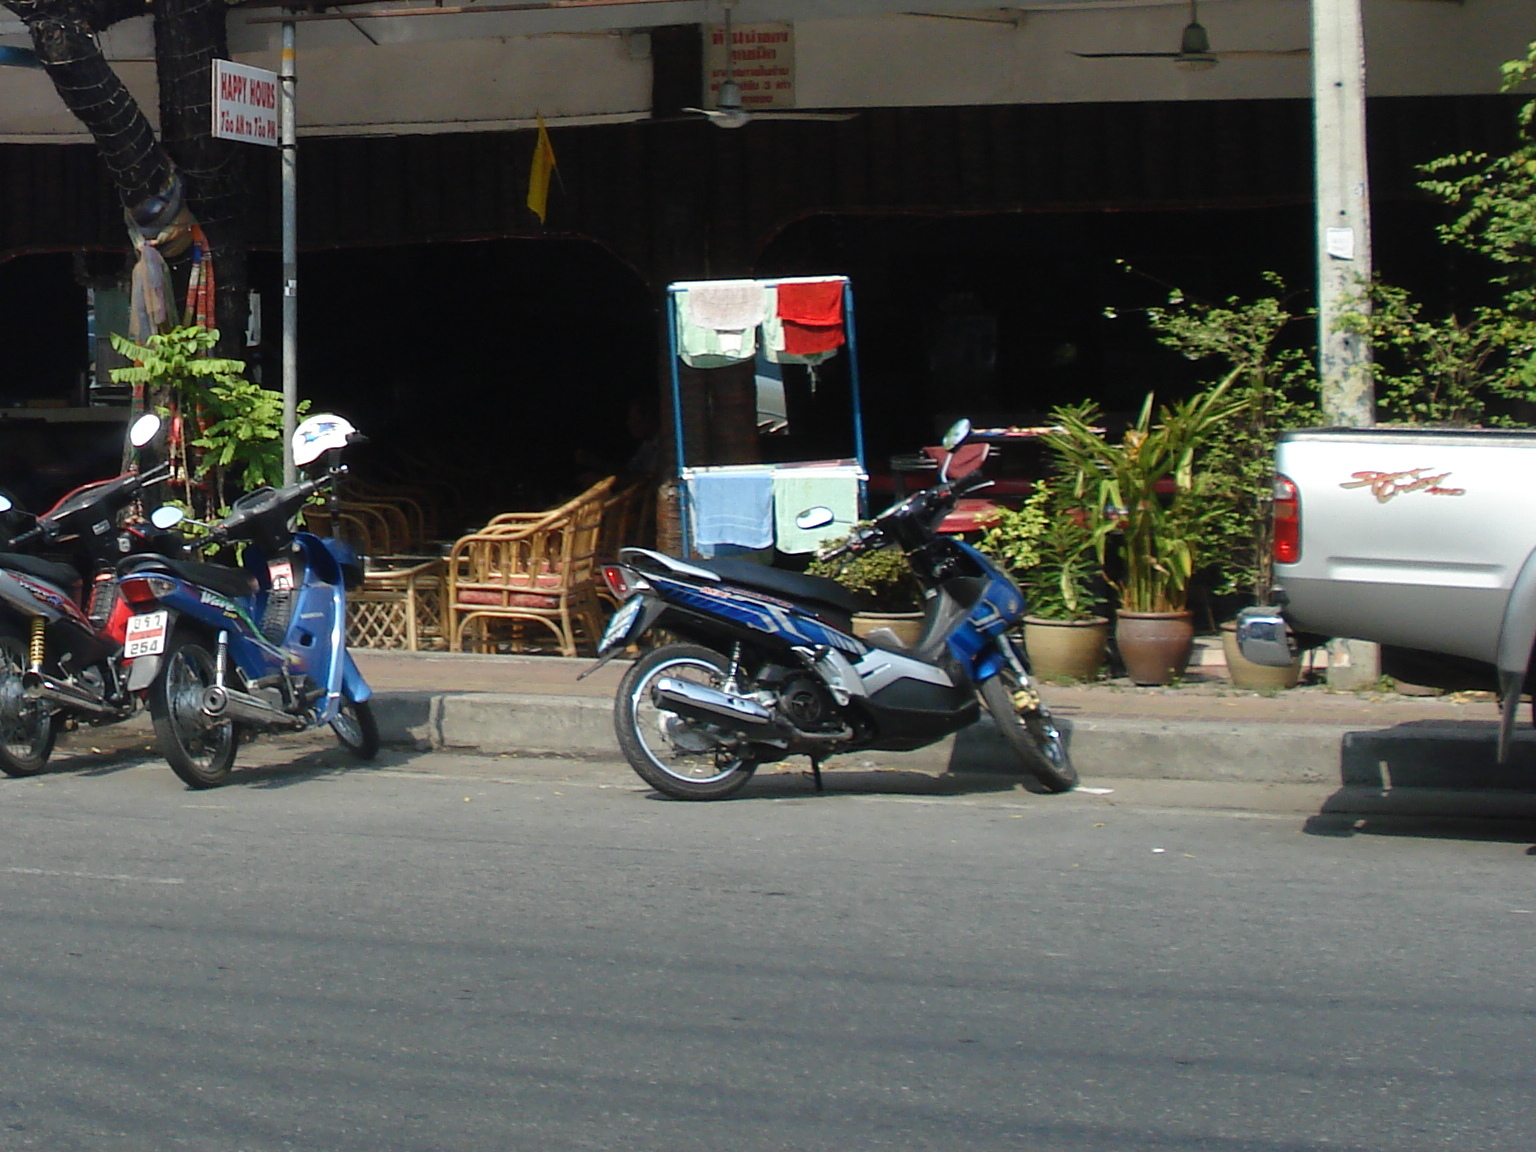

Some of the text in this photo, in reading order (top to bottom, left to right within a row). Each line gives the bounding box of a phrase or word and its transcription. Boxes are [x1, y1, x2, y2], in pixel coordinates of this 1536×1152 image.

[221, 72, 276, 110] HAPPY HOURS
[200, 591, 237, 612] Wave
[130, 639, 159, 656] 254
